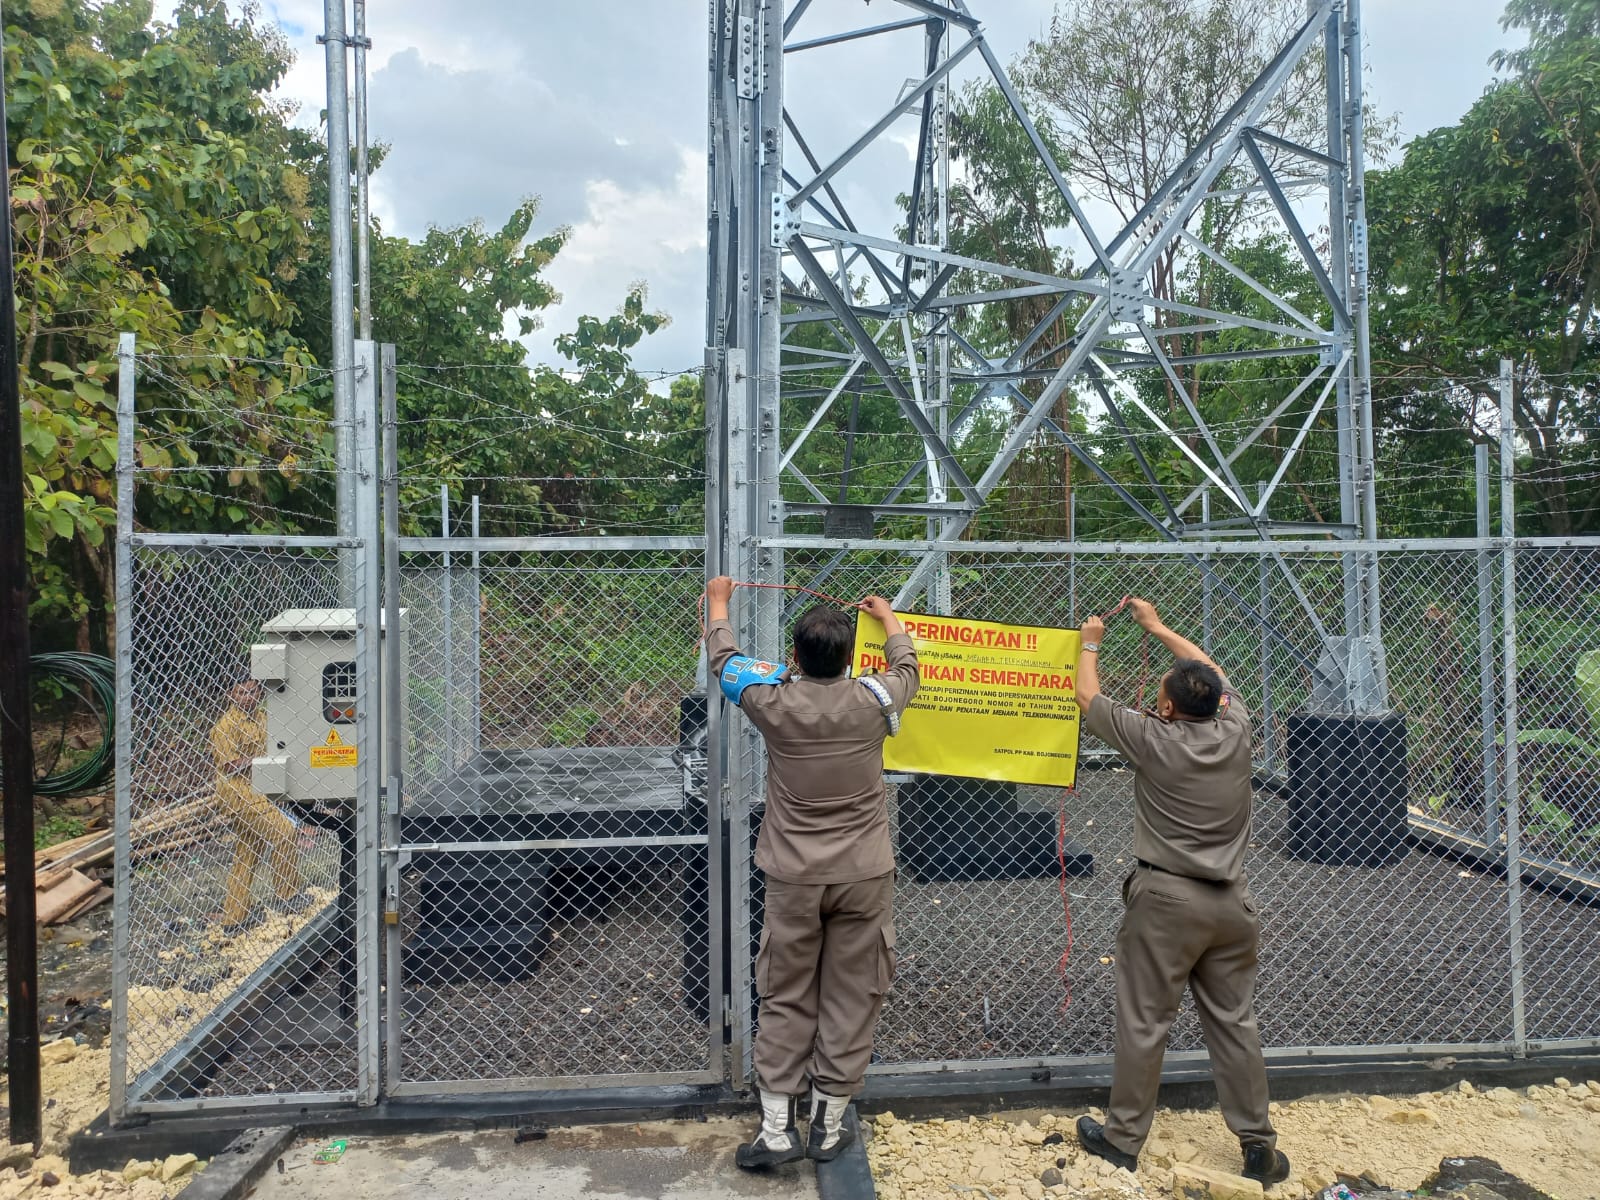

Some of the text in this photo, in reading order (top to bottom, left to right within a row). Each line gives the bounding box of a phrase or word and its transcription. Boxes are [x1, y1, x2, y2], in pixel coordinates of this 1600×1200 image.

[905, 621, 1037, 649] PERINGATAN !!
[864, 642, 885, 651] OPERA
[940, 652, 962, 660] USAHA
[1064, 663, 1074, 671] INI
[970, 668, 1074, 690] SEMENTARA
[919, 685, 1076, 703] NGKAPI PERIZINAN YANG DIPERSYARATKAN DALAM
[933, 695, 983, 705] BOJONEGORO
[1030, 702, 1053, 710] TAHUN
[955, 707, 989, 715] PENATAAN
[992, 709, 1019, 717] MENARA
[1022, 711, 1075, 721] TELEKOMUNIKASI
